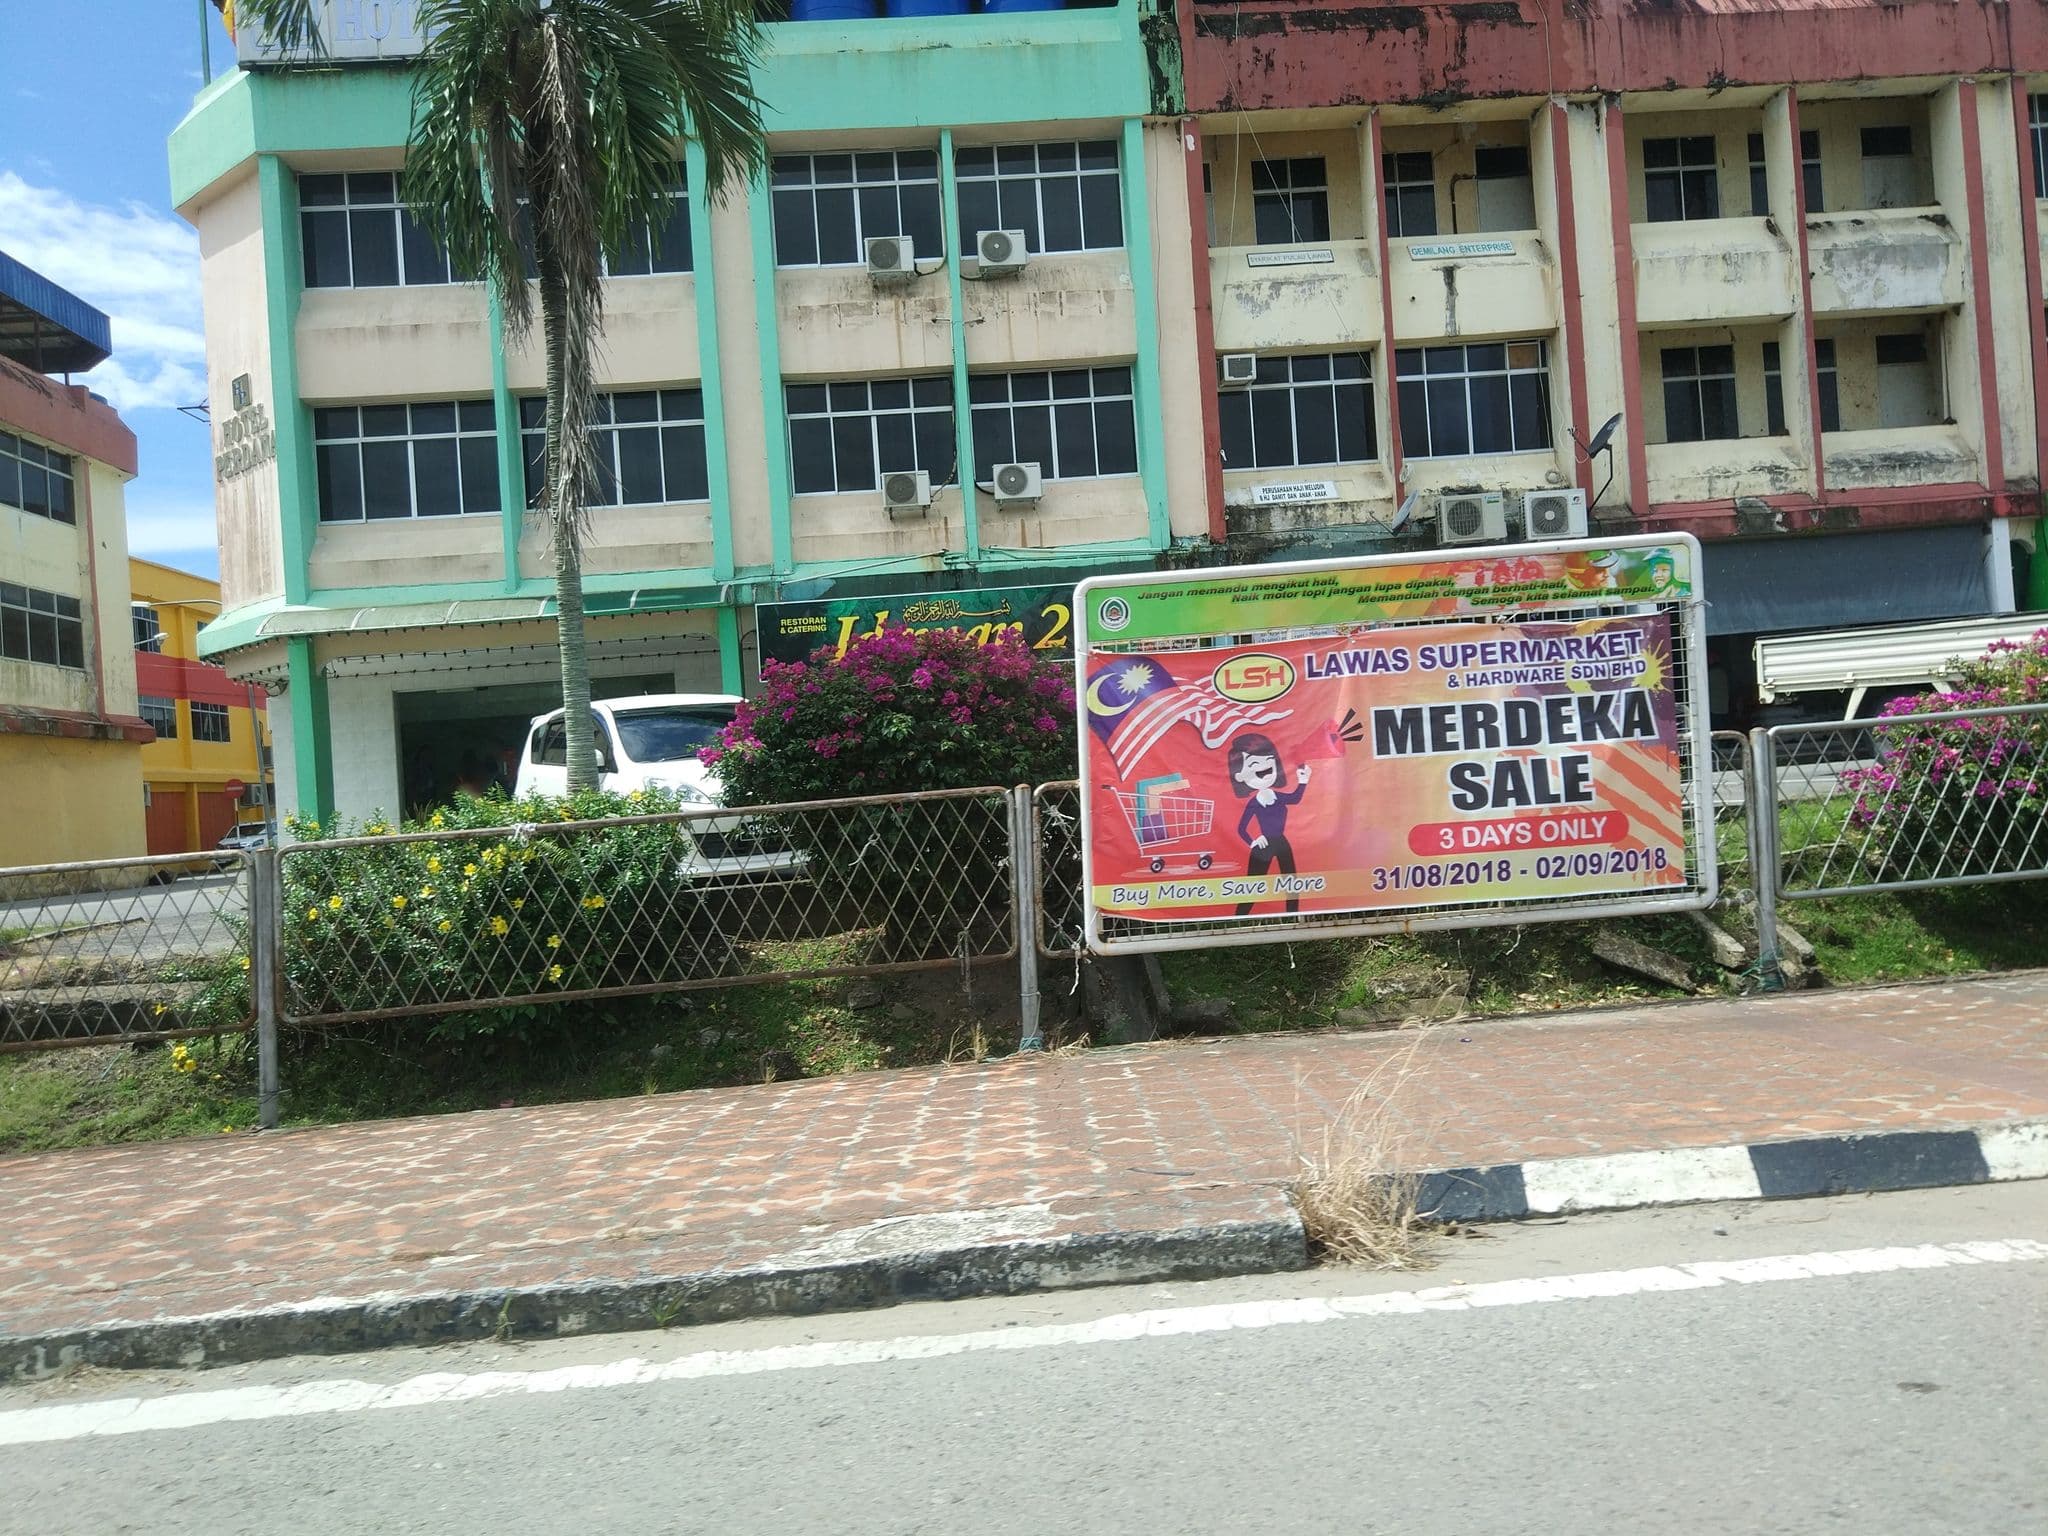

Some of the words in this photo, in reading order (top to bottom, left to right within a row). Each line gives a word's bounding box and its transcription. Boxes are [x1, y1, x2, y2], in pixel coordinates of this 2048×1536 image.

[1411, 246, 1455, 256] GEMILANG
[1459, 242, 1513, 253] ENTERPRISE
[222, 403, 269, 448] HOTEL
[1262, 485, 1293, 494] PERUSAHAAN
[1137, 589, 1184, 601] Jangan
[1187, 584, 1249, 596] memandu
[1252, 579, 1311, 592] mengikut
[1231, 593, 1259, 603] Naik
[1262, 590, 1298, 601] motor
[1301, 588, 1326, 600] topi
[1327, 583, 1371, 597] jangan
[1375, 582, 1403, 593] lupa
[1357, 591, 1439, 604] Memandulah
[1442, 586, 1490, 598] dengan
[1470, 596, 1523, 606] Semoga
[1526, 592, 1549, 602] kita
[1552, 588, 1602, 600] selamat
[780, 617, 827, 626] RESTORAN
[788, 625, 827, 634] CATERING
[1033, 603, 1071, 649] 2
[1305, 648, 1410, 681] LAWAS
[1421, 630, 1644, 673] SUPERMARKET
[1224, 668, 1285, 687] LSH
[1447, 674, 1461, 688] &
[1465, 667, 1565, 686] HARDWARE
[1570, 663, 1606, 681] SDN
[1610, 659, 1647, 678] BHD
[1373, 690, 1657, 757] MERDEKA
[1449, 754, 1593, 811] SALE
[1439, 828, 1455, 849] 3
[1463, 821, 1531, 847] DAYS
[1539, 816, 1607, 844] ONLY
[1373, 860, 1511, 891] 31/08/2018
[1536, 848, 1667, 879] 02/09/2018
[1112, 887, 1151, 907] Buy
[1157, 882, 1214, 902] More,
[1222, 877, 1267, 898] Save
[1275, 873, 1325, 894] More
